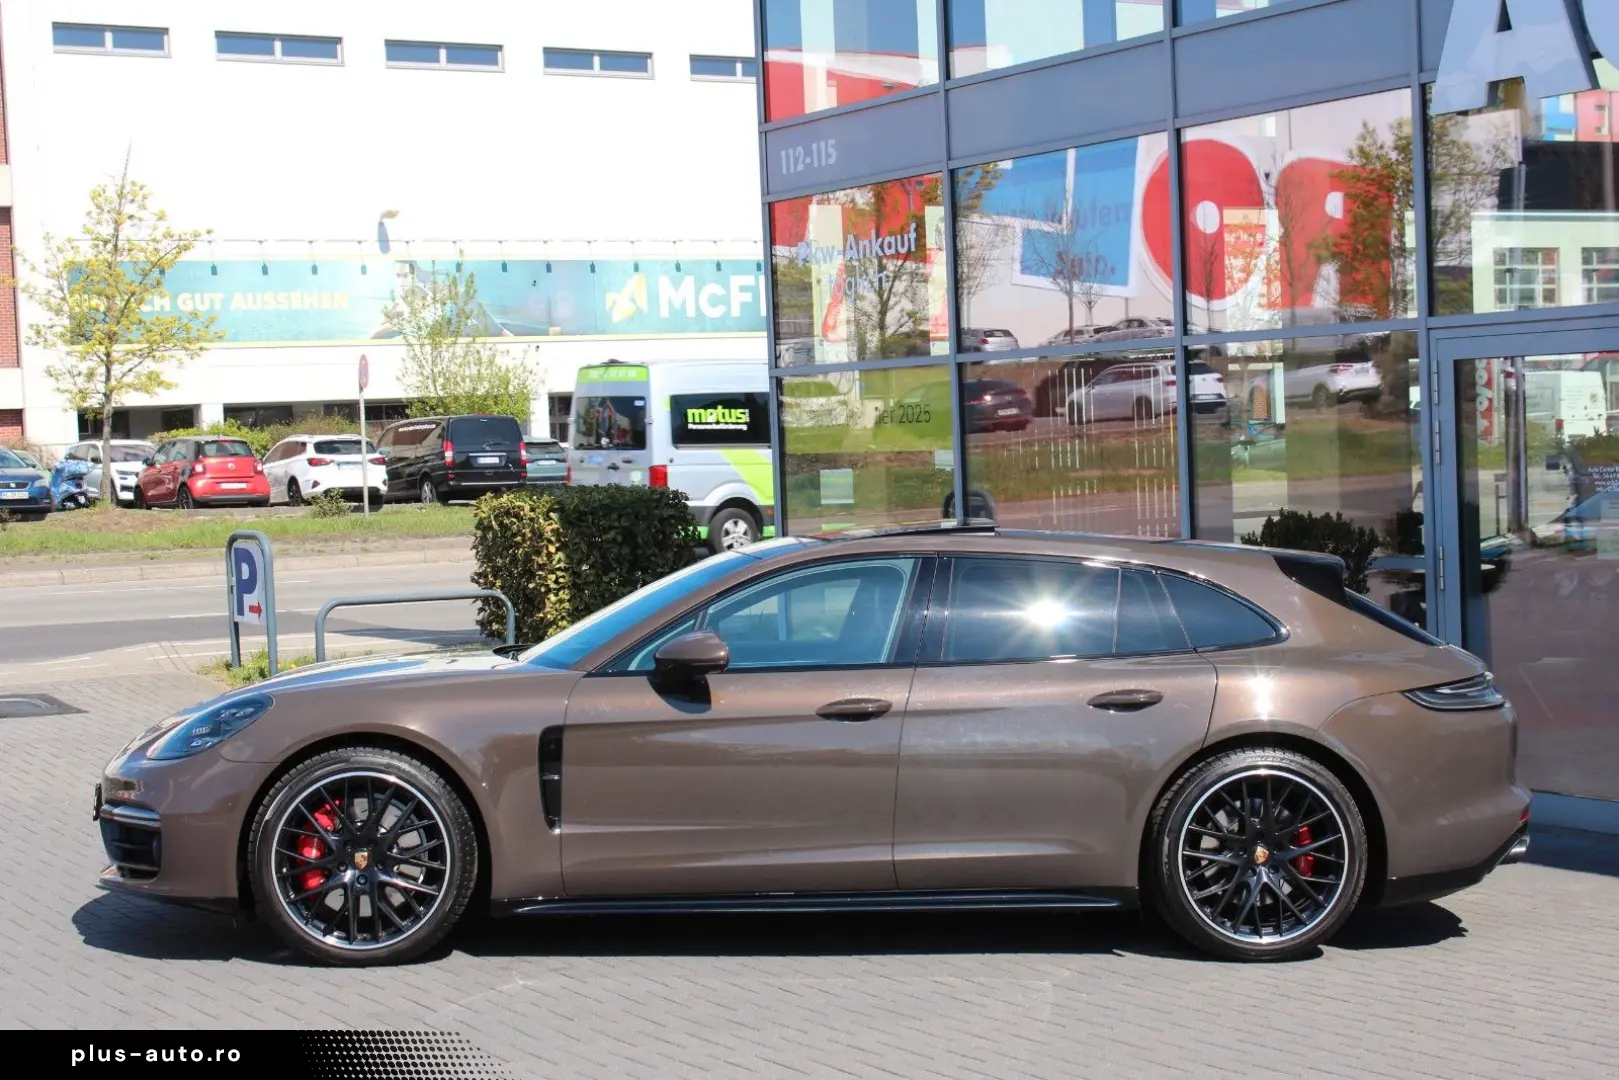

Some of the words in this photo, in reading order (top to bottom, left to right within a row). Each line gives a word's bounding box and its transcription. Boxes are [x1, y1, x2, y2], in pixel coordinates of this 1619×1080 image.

[780, 139, 838, 175] 112-115
[176, 292, 224, 312] GUT
[229, 291, 349, 311] AUSSEHEN
[686, 405, 747, 423] motus
[898, 404, 931, 424] 2025
[233, 546, 258, 617] P
